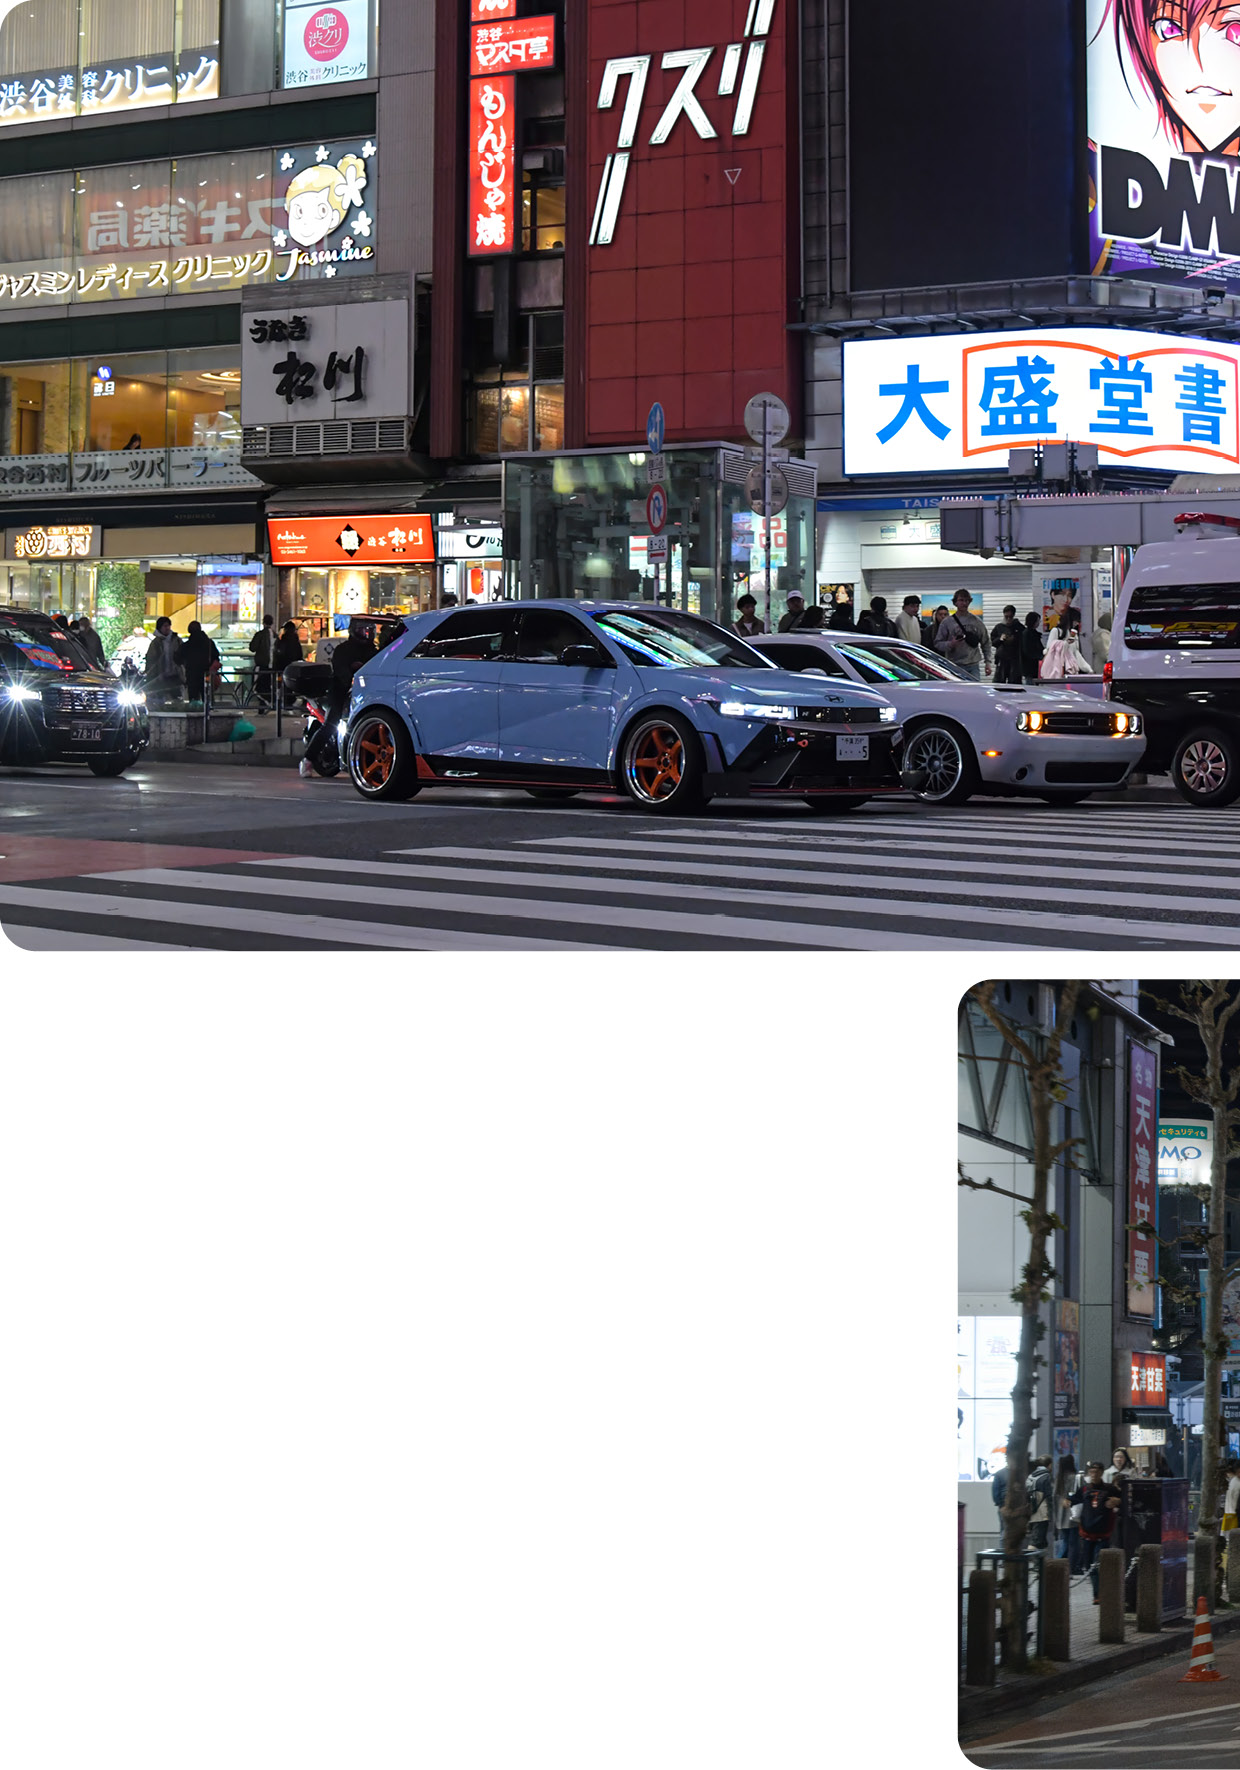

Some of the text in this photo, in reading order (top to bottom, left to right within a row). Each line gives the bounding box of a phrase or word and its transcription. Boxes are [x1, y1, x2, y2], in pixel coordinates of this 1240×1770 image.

[477, 27, 502, 43] 渋谷
[597, 40, 767, 148] クスリ
[477, 85, 507, 246] もんじゃ焼
[173, 250, 272, 282] クリニック
[276, 238, 374, 282] Jasmine
[249, 315, 308, 343] うなぎ
[272, 345, 366, 406] 松川
[1158, 1127, 1206, 1138] セキュリティも
[1158, 1145, 1202, 1160] MO
[1131, 1366, 1164, 1392] 天津甘栗
